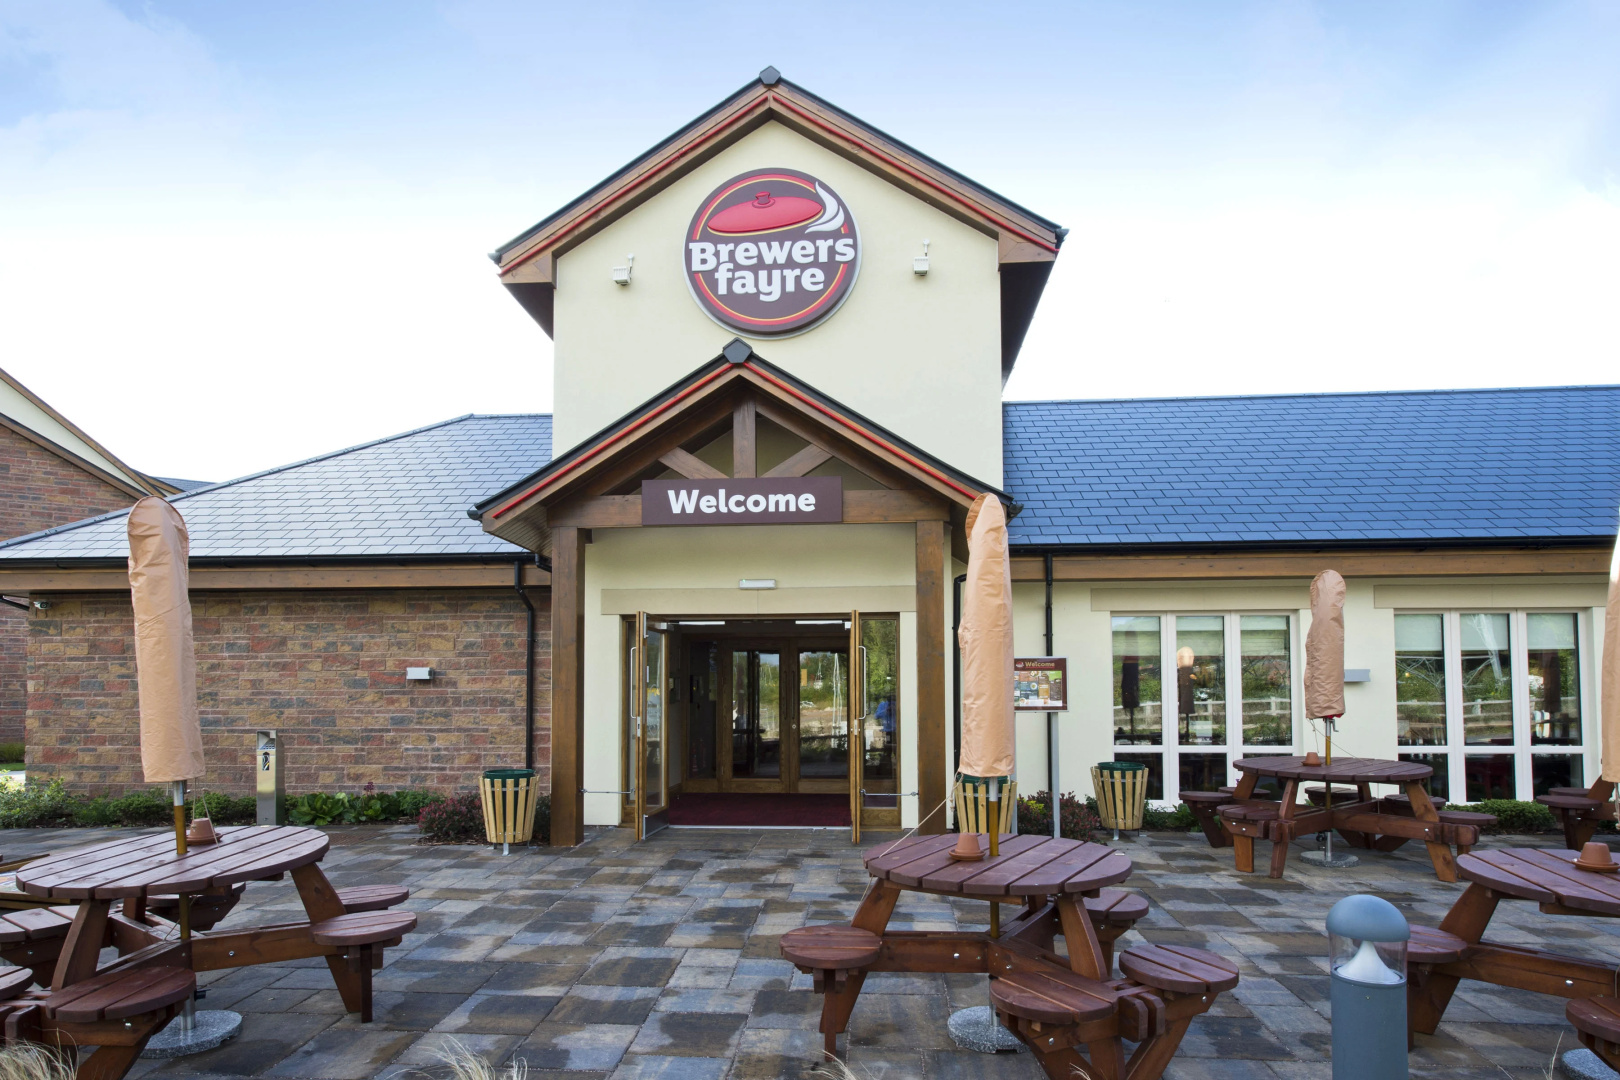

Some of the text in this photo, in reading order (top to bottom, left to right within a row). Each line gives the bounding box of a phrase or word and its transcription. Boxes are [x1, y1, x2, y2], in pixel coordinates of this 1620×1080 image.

[689, 238, 855, 271] Brewers
[715, 263, 825, 302] fayre
[667, 488, 816, 514] Welcome
